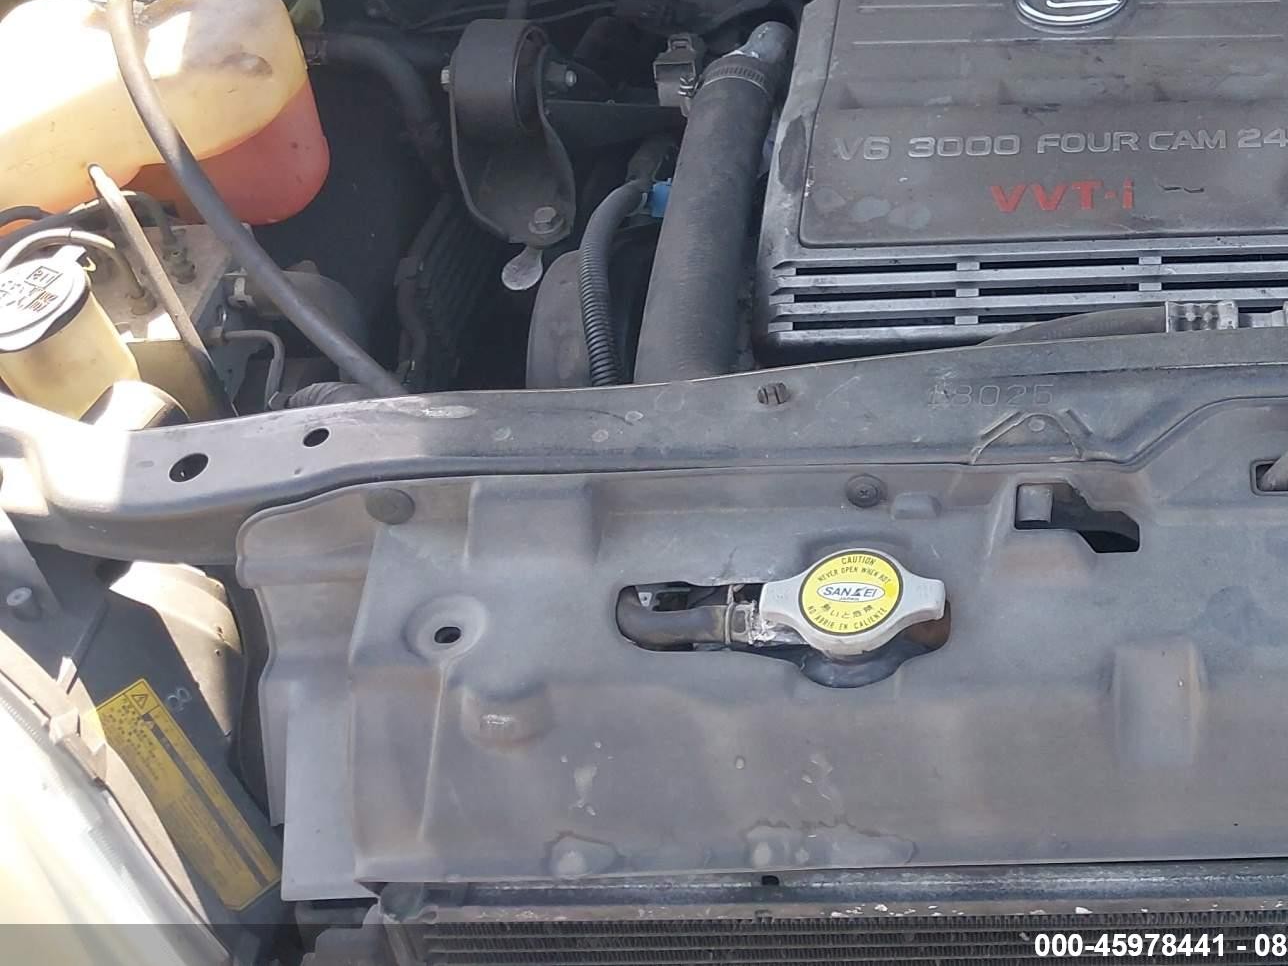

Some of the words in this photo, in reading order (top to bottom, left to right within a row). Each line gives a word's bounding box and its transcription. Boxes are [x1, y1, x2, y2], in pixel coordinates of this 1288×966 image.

[834, 137, 890, 160] V6
[908, 135, 1020, 157] 3000
[1037, 131, 1139, 154] FOUR
[1150, 129, 1227, 150] CAM
[1237, 128, 1288, 148] 24
[989, 178, 1135, 213] VVT-i
[841, 556, 877, 565] CAUTION
[817, 569, 838, 582] NEVER
[841, 566, 858, 574] OPEN
[861, 567, 878, 577] WHEN
